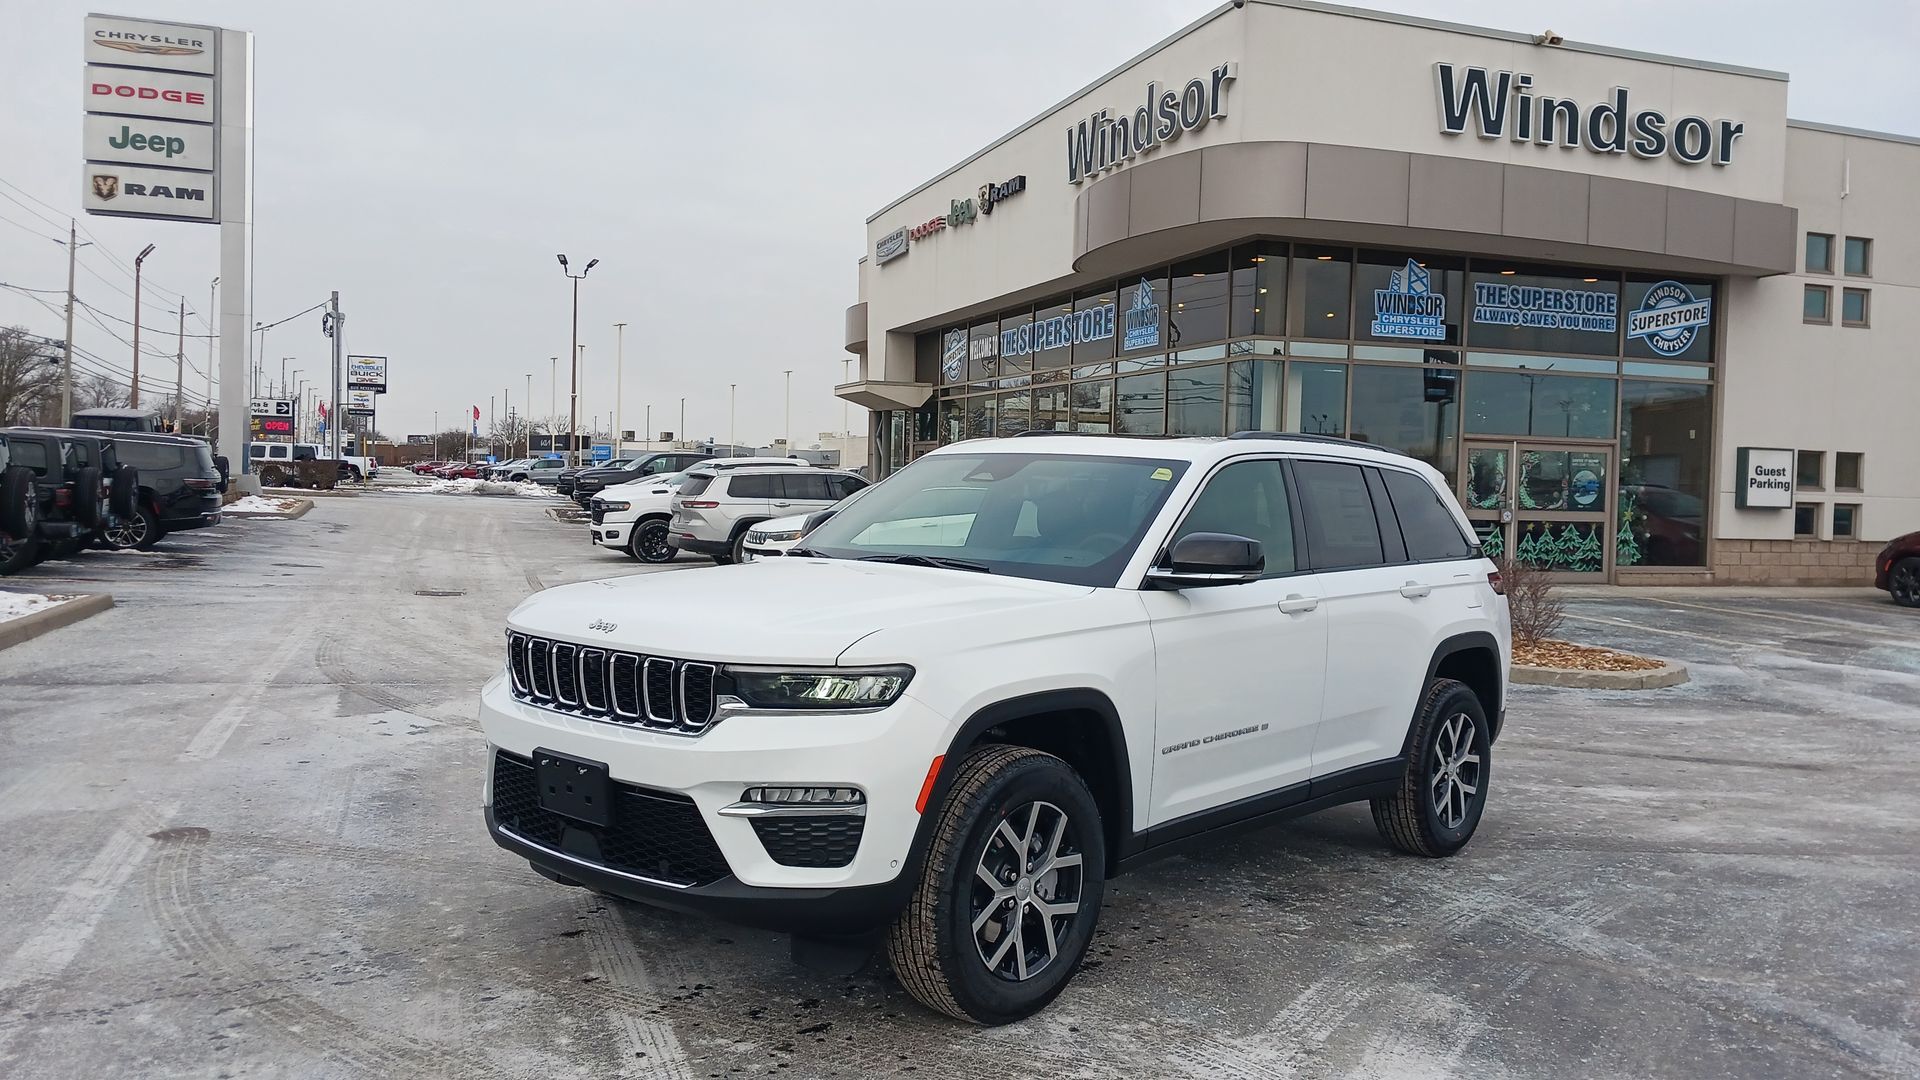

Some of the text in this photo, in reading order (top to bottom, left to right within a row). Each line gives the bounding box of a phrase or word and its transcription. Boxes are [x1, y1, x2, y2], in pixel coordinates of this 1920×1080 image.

[95, 30, 203, 47] CHRYSLER
[92, 83, 205, 105] DODGE
[1067, 62, 1237, 184] Windsor
[1433, 61, 1745, 167] Windsor
[109, 126, 185, 158] Jeep
[125, 183, 204, 201] RAM
[990, 175, 1026, 202] RAM
[947, 199, 978, 226] Jeep
[910, 215, 946, 241] DODGE
[876, 230, 904, 249] CHRYSLER
[1377, 292, 1444, 317] WINDSOR
[1475, 283, 1617, 315] THE SUPERSTORE
[1648, 286, 1686, 306] WINDSOR
[1127, 306, 1158, 330] WINDSOR
[1382, 315, 1436, 326] CHRYSLER
[1474, 307, 1616, 332] ALWAYS SAVES YOU MORE!
[1631, 306, 1707, 332] SUPERSTORE
[1001, 303, 1115, 357] THE SUPERSTORE
[1125, 334, 1158, 347] SUPERSTORE
[1129, 326, 1156, 338] CHRYSLER
[1374, 324, 1444, 337] SUPERSTORE
[1653, 330, 1691, 351] CHRYSLER
[265, 421, 289, 430] OPEN
[1755, 465, 1786, 476] Guest
[1749, 477, 1791, 492] Parking
[588, 618, 618, 634] Jeep
[1162, 724, 1259, 755] GRAND CHEROKEE
